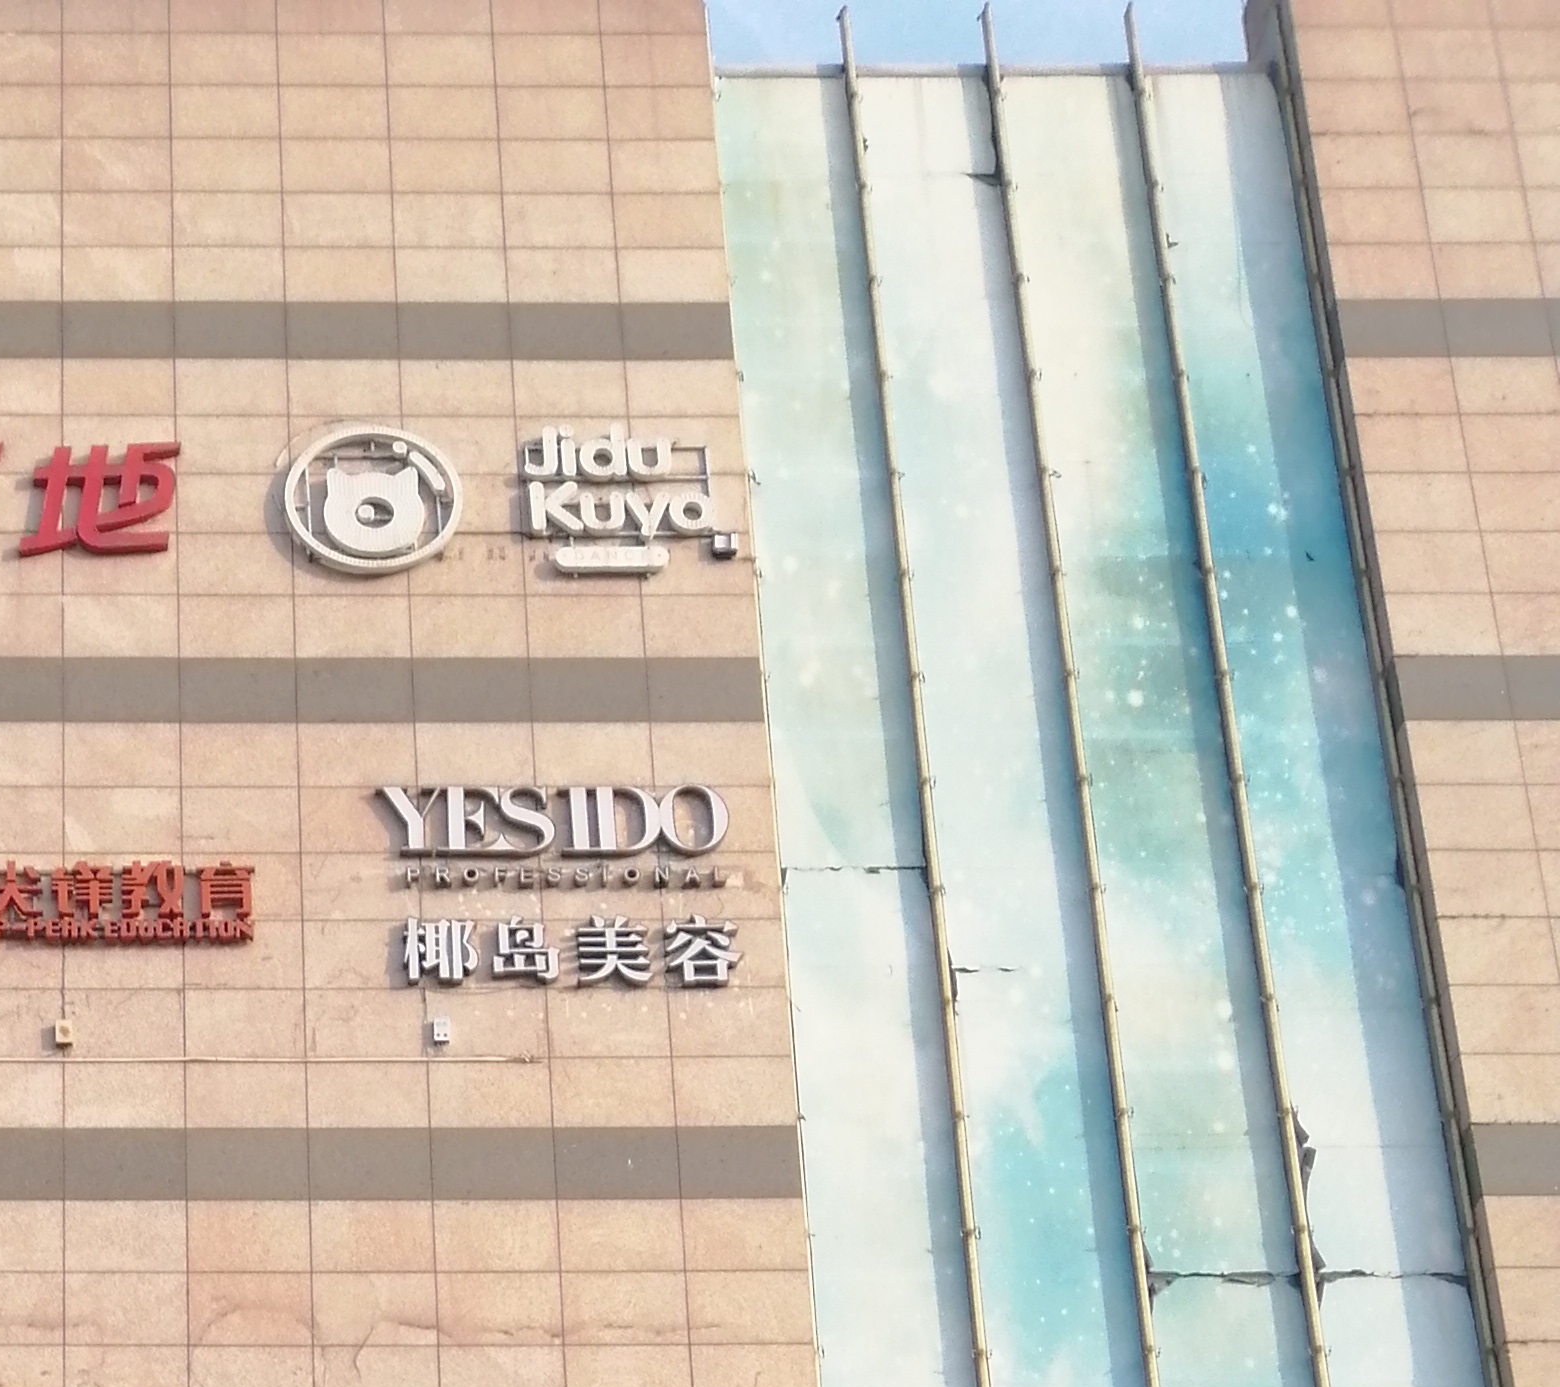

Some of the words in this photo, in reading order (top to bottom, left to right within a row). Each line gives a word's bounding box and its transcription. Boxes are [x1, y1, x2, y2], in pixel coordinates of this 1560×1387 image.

[523, 421, 672, 482] Jidu
[375, 785, 730, 857] YESIDO
[404, 866, 728, 888] PROFESSIONAL
[104, 917, 254, 943] EDUCATION
[403, 914, 743, 988] 椰岛美容
